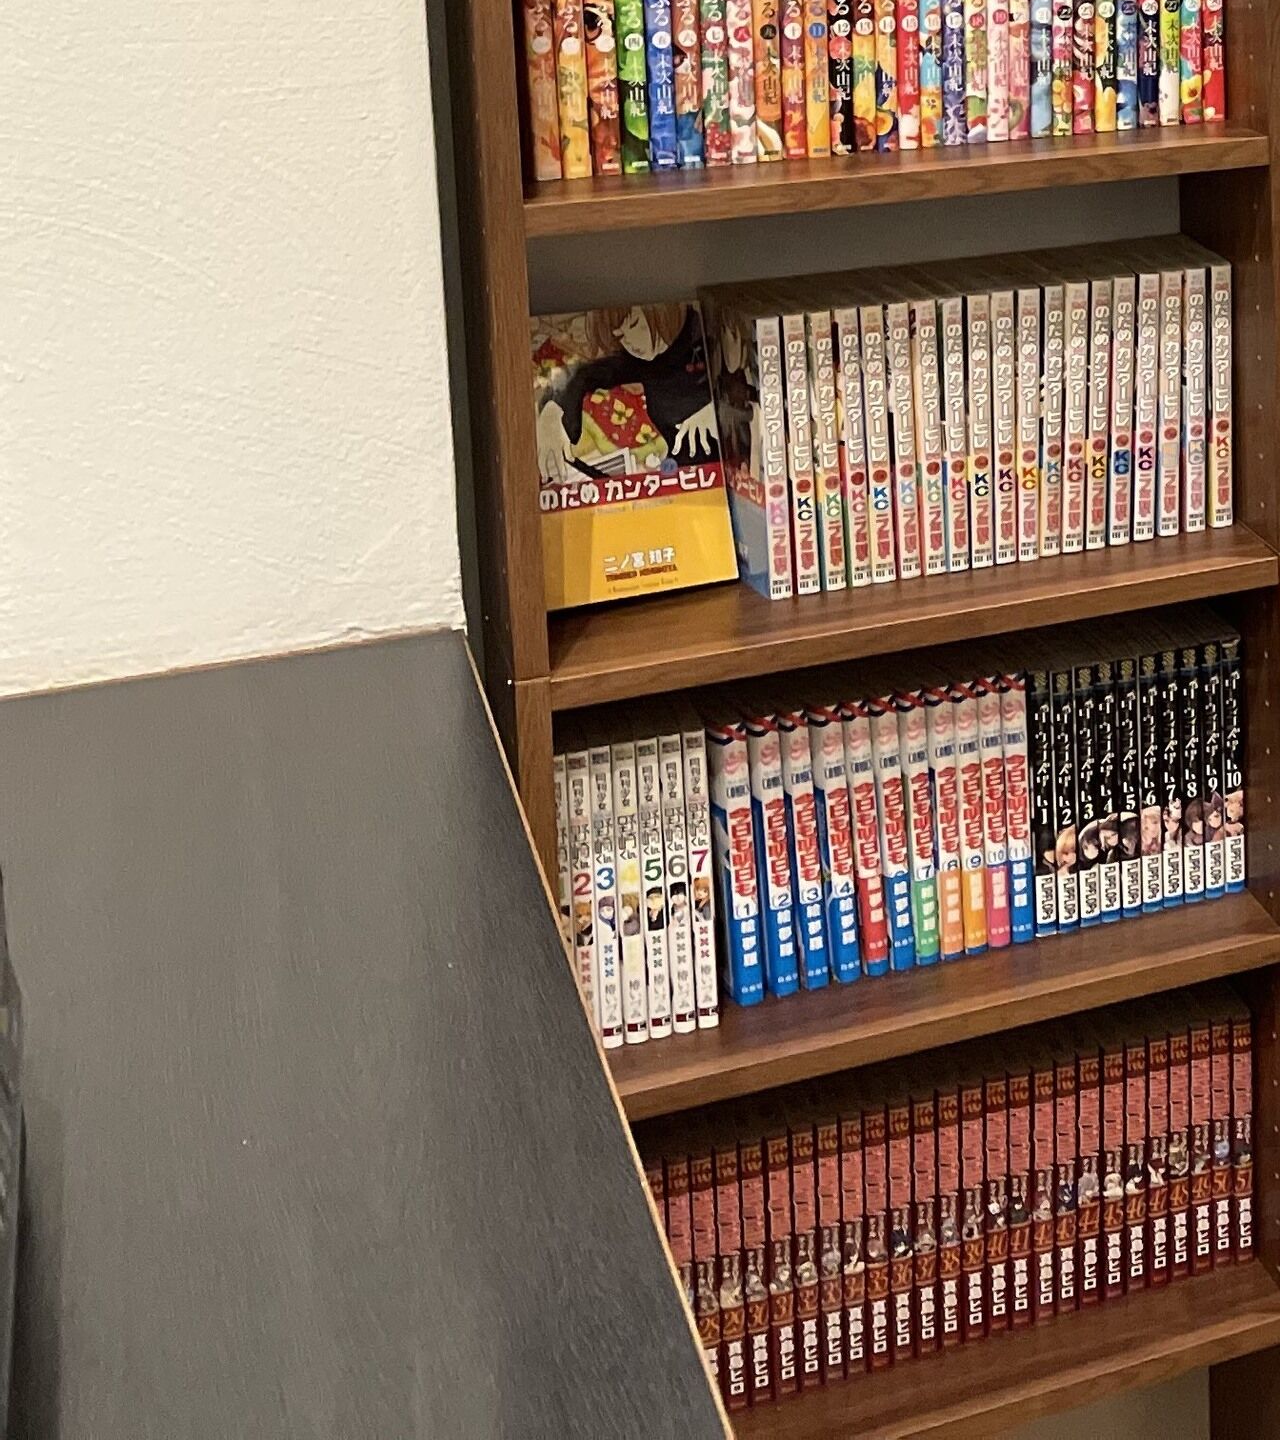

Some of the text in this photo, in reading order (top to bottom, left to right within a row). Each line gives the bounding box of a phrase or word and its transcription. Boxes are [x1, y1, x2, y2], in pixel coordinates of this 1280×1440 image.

[540, 468, 716, 510] のだめ カンタービレ
[1226, 771, 1242, 788] 10
[1061, 809, 1072, 825] 2
[644, 859, 663, 882] 5
[691, 850, 708, 875] 7
[596, 867, 615, 891] 3
